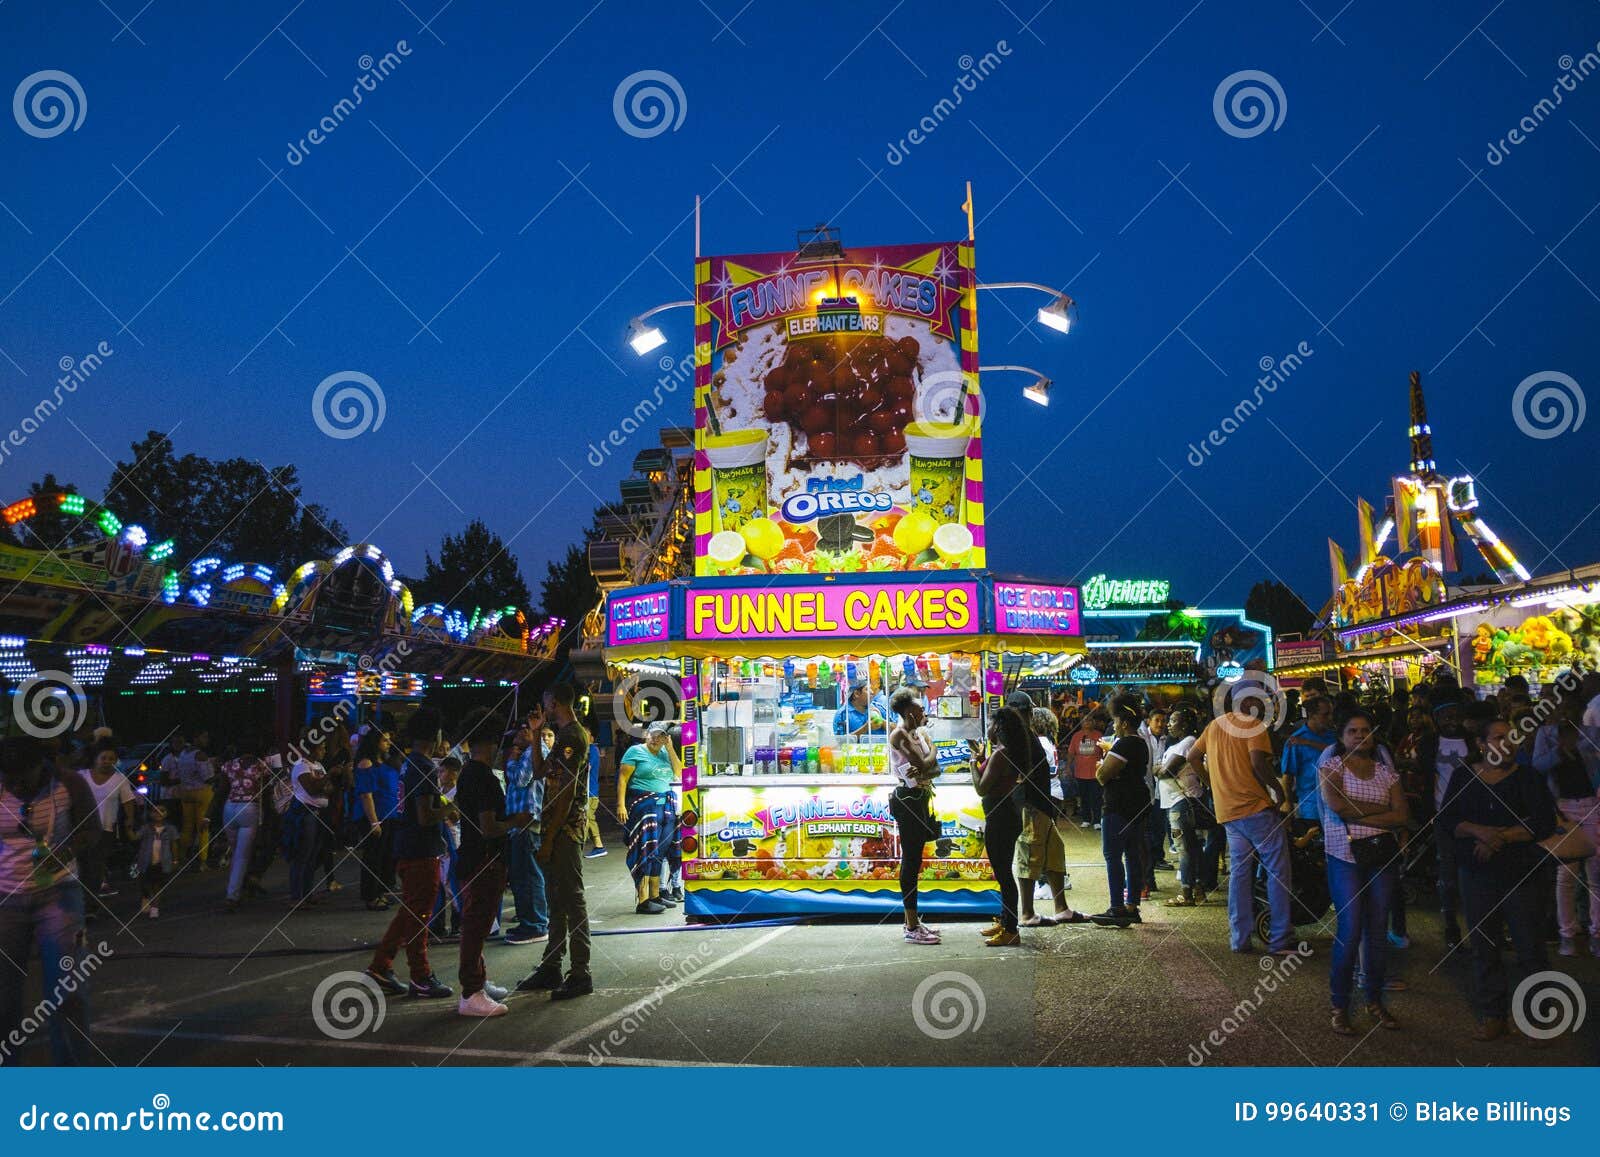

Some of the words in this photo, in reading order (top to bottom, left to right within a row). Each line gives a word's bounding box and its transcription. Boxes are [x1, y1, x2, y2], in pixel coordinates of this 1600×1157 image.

[844, 269, 937, 317] CAKES
[789, 314, 846, 336] ELEPHANT
[849, 313, 880, 332] EARS
[806, 473, 864, 492] Fried
[784, 491, 892, 520] OREOS
[998, 586, 1027, 607] ICE
[1029, 589, 1074, 610] COLD
[1082, 574, 1169, 609] AVENGERS
[613, 601, 632, 620] ICE
[634, 595, 667, 618] COLD
[694, 591, 838, 634] FUNNEL
[844, 588, 970, 631] CAKES
[1005, 608, 1071, 630] DRINKS
[616, 618, 663, 640] DRINKS
[771, 800, 847, 827] FUNNEL
[808, 823, 853, 834] ELEPHANT
[853, 823, 876, 834] EARS
[931, 860, 994, 875] LEMONAD
